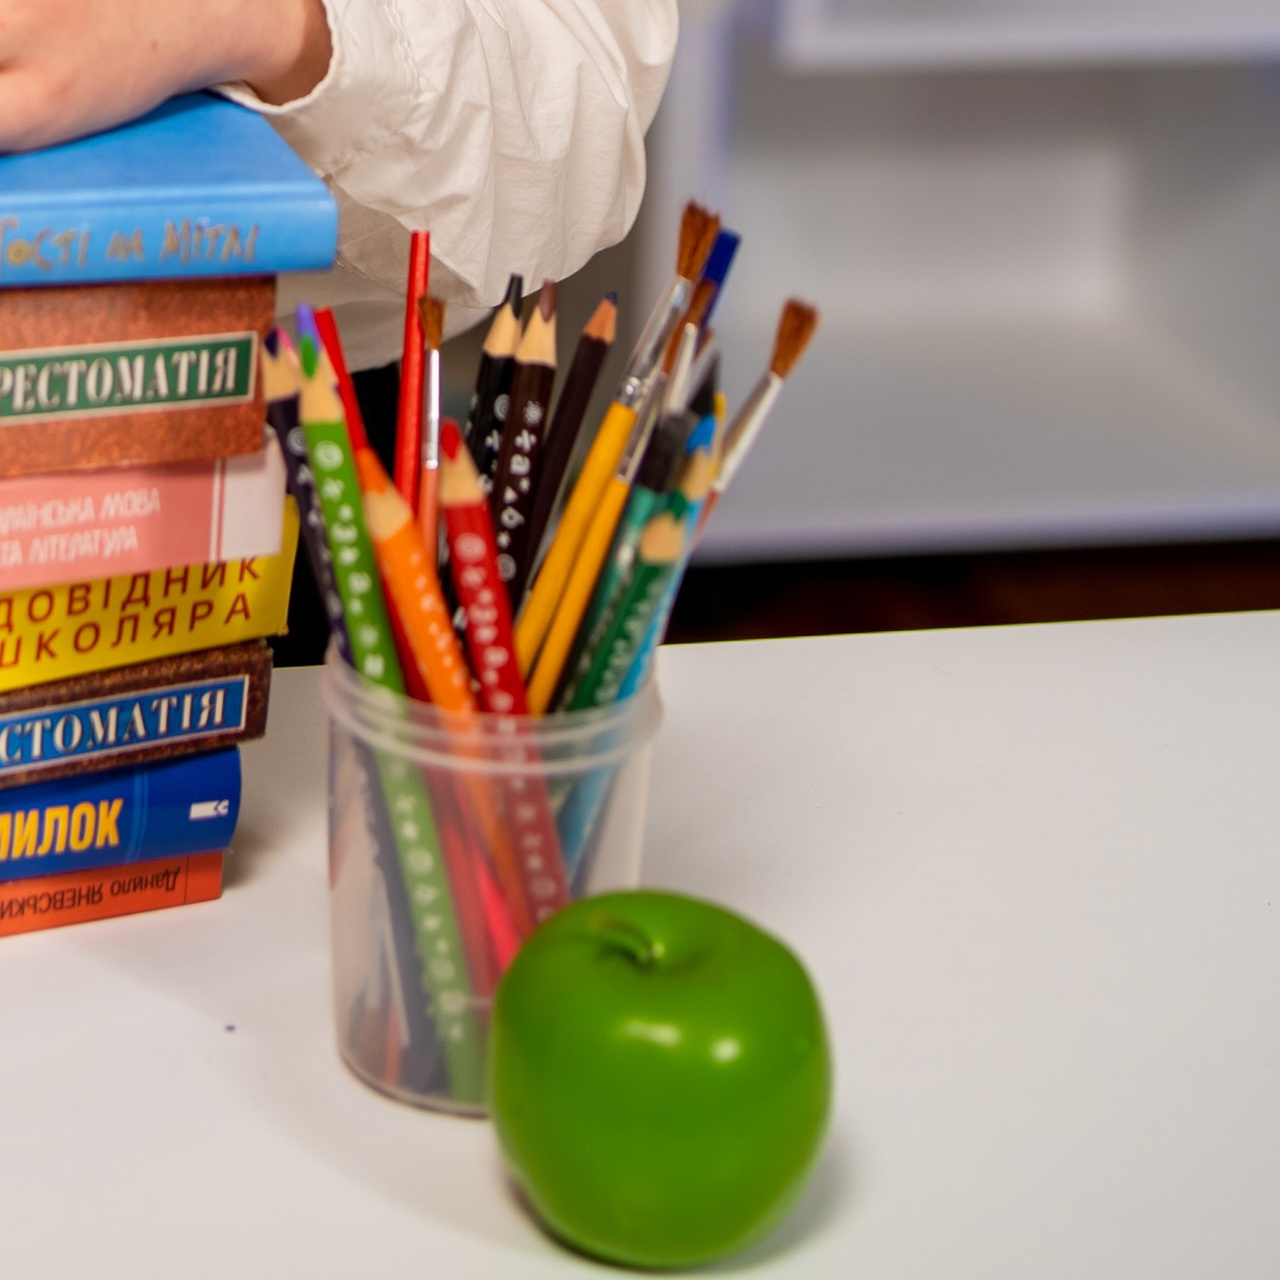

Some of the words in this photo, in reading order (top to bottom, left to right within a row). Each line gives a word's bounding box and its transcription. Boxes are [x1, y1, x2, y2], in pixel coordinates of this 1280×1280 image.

[100, 487, 160, 520] МОВА
[0, 539, 23, 568] ТА
[28, 525, 138, 564] ЛІТЕРАТУРА
[109, 866, 181, 897] Данило
